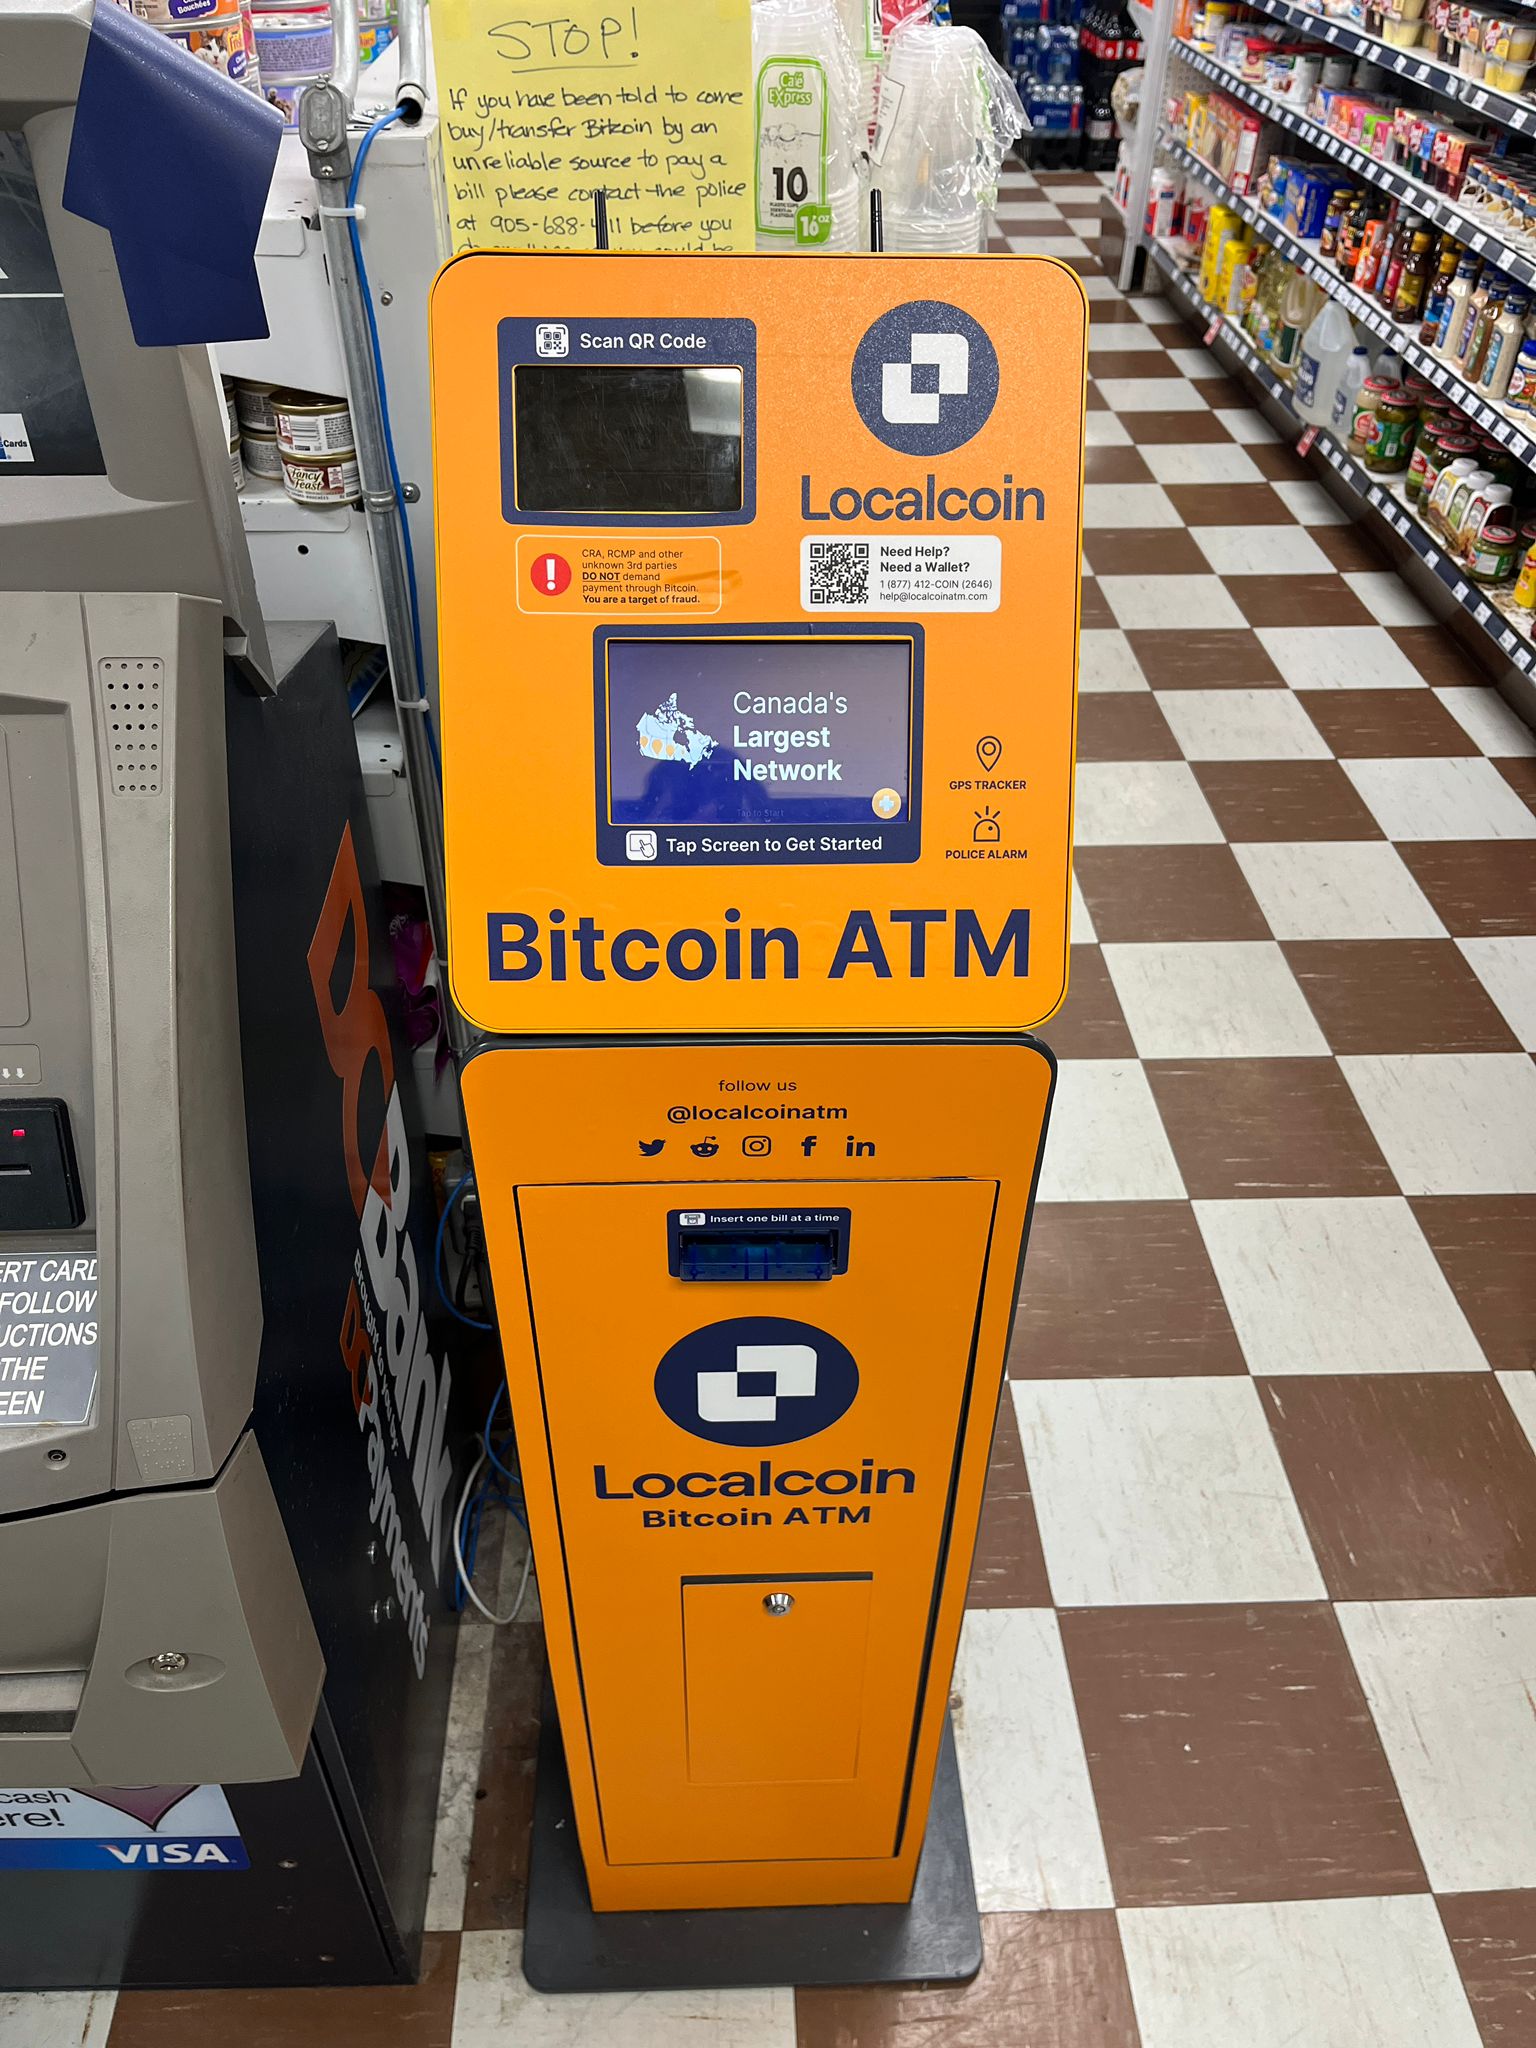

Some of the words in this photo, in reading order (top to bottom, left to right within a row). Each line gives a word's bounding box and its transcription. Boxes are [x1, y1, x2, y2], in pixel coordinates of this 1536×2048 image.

[488, 7, 639, 59] STOP!
[779, 72, 804, 88] Café
[449, 88, 467, 111] If
[476, 95, 511, 118] you
[516, 90, 555, 107] have
[561, 87, 612, 105] been
[616, 85, 657, 103] told
[666, 85, 688, 103] to
[697, 91, 743, 104] come
[447, 117, 577, 151] buy/transfer
[581, 118, 652, 138] Bitcoin
[663, 116, 684, 144] by
[691, 122, 717, 134] an
[453, 151, 562, 170] unreliable
[569, 156, 631, 170] source
[638, 149, 658, 167] to
[666, 154, 706, 180] pay
[710, 154, 727, 166] a
[454, 182, 485, 200] bill
[495, 184, 559, 208] please
[568, 182, 641, 201] contact
[646, 183, 685, 197] the
[696, 180, 746, 208] police
[773, 166, 808, 202] 10
[457, 214, 476, 231] at
[631, 215, 693, 235] before
[698, 219, 732, 240] you
[800, 215, 819, 237] 16
[580, 333, 624, 349] Scan
[629, 333, 654, 349] QR
[660, 333, 707, 349] Code
[291, 468, 322, 482] Fancy
[295, 478, 323, 490] Feast
[801, 474, 1045, 521] Localcoin
[582, 549, 604, 559] CRA,
[607, 550, 636, 558] RCMP
[638, 549, 656, 558] and
[658, 549, 683, 558] other
[880, 546, 911, 557] Need
[915, 546, 949, 559] Help?
[582, 561, 624, 569] unknown
[627, 561, 643, 569] 3rd
[645, 561, 677, 572] parties
[582, 572, 597, 580] DO
[599, 572, 620, 580] NOT
[623, 572, 660, 581] demand
[880, 562, 911, 572] Need
[914, 564, 922, 572] a
[925, 562, 970, 572] Wallet?
[582, 584, 623, 593] payment
[625, 584, 661, 593] through
[664, 584, 699, 592] Bitcoin.
[880, 580, 884, 588] 1
[887, 580, 911, 589] (877)
[914, 580, 959, 588] 412-COIN
[962, 580, 992, 589] (2646)
[583, 595, 600, 603] You
[628, 595, 657, 605] target
[660, 595, 669, 603] of
[671, 595, 700, 603] fraud.
[880, 592, 987, 602] help@localcoinatm.com
[733, 692, 848, 714] Canada's
[733, 725, 831, 753] Largest
[733, 759, 842, 781] Network
[949, 781, 972, 790] GPS
[975, 780, 1026, 789] TRACKER
[666, 838, 697, 855] Tap
[701, 838, 759, 852] Screen
[765, 838, 781, 851] to
[786, 837, 815, 851] Get
[820, 836, 882, 850] Started
[946, 850, 985, 859] POLICE
[987, 850, 1027, 859] ALARM
[487, 908, 799, 981] Bitcoin
[828, 908, 1030, 979] ATM
[718, 1080, 770, 1091] follow
[777, 1082, 797, 1091] us
[667, 1104, 848, 1124] @localcoinatm
[710, 1215, 744, 1223] Insert
[771, 1214, 788, 1222] bill
[790, 1214, 801, 1222] at
[814, 1213, 840, 1222] time
[0, 1290, 97, 1314] FOLLOW
[354, 1248, 381, 1353] Brought
[376, 1346, 386, 1373] to
[1, 1357, 48, 1381] THE
[593, 1458, 916, 1500] Localcoin
[643, 1507, 771, 1528] Bitcoin
[783, 1505, 871, 1525] ATM
[105, 1843, 230, 1863] VISA
